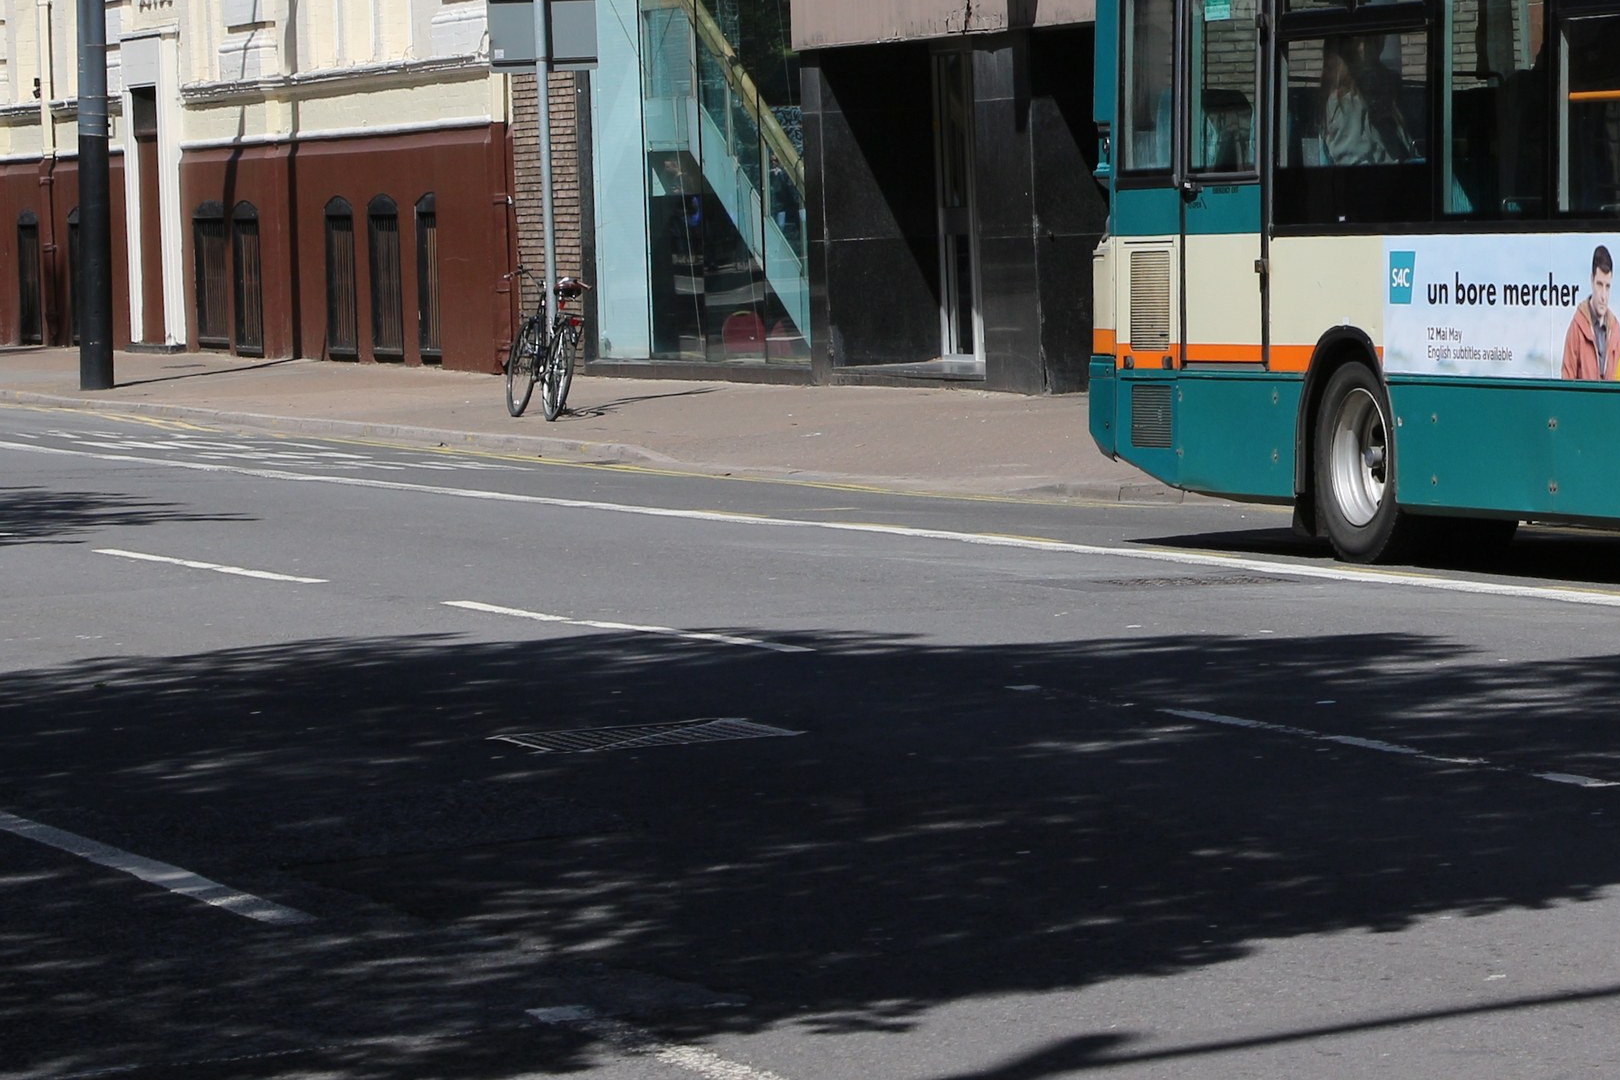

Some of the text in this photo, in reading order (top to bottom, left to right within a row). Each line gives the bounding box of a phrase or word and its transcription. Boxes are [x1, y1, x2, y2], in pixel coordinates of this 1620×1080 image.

[1391, 267, 1411, 288] S4C
[1427, 271, 1580, 307] un bore mercher
[1427, 326, 1463, 344] 12 Mai May
[1427, 344, 1513, 362] English subtitles available
